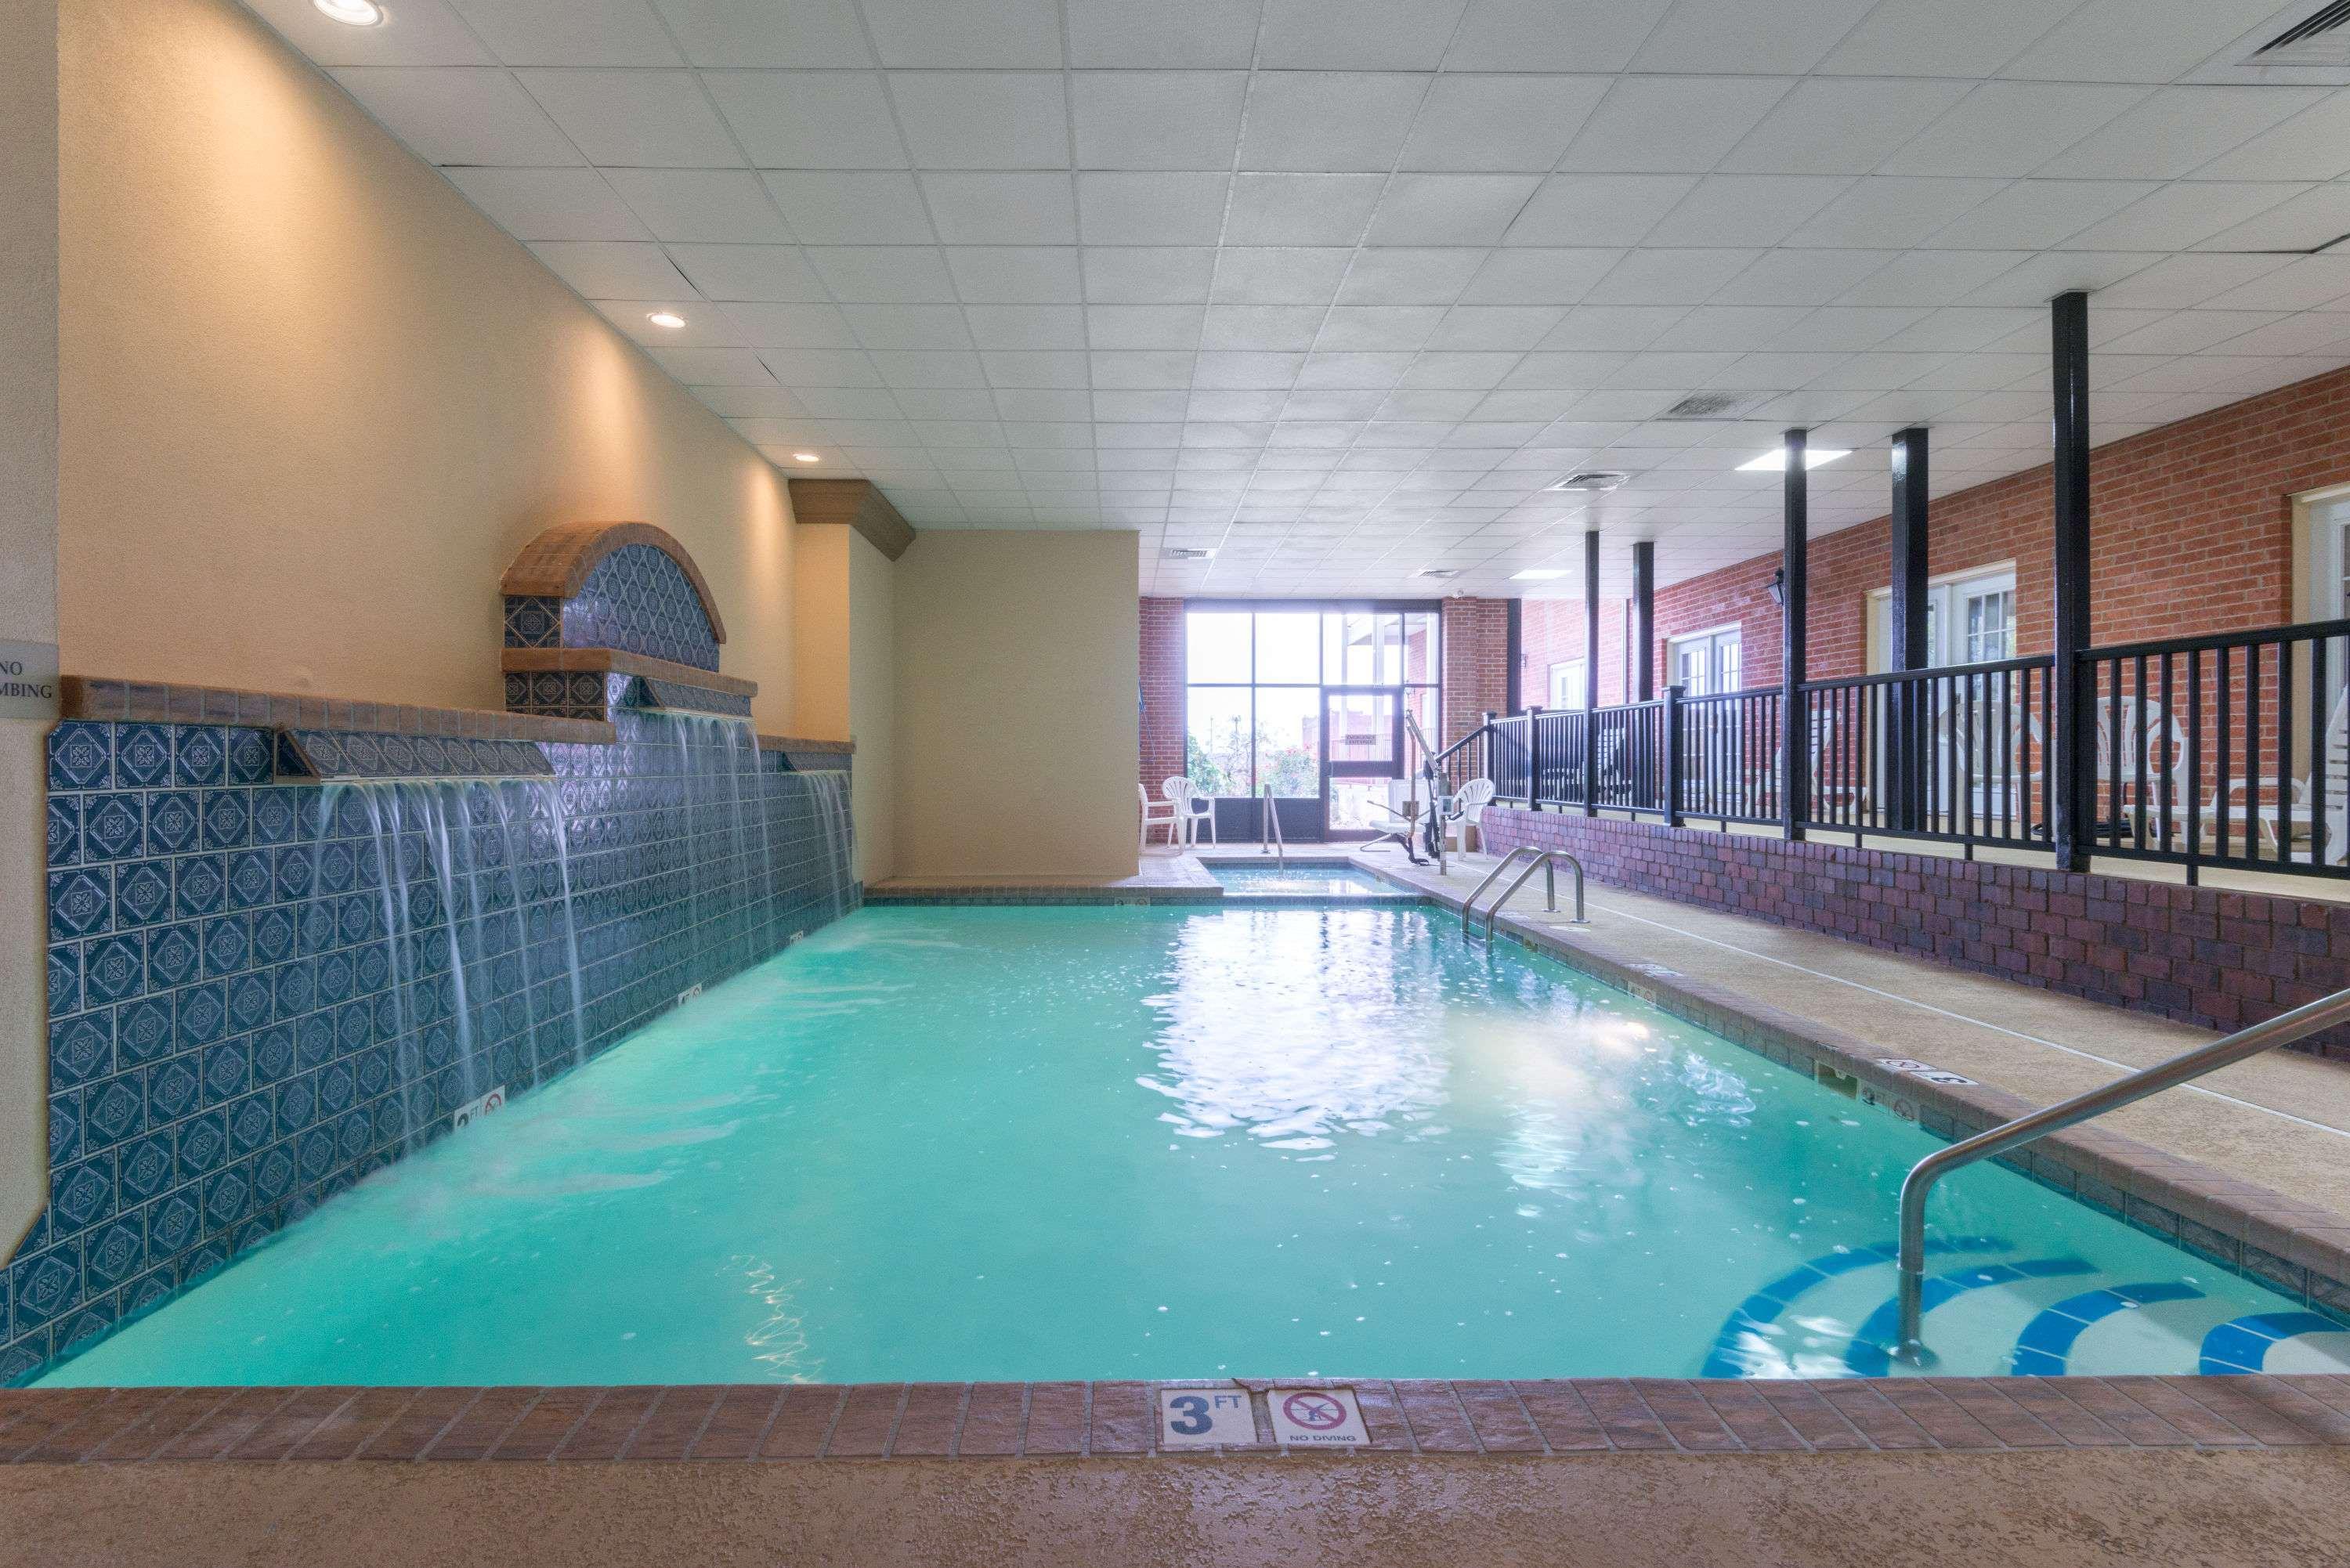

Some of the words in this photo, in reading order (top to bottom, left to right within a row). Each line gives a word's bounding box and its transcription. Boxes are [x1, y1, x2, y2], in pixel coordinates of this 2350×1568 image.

[0, 661, 22, 675] NO
[1170, 1396, 1213, 1435] 3
[1215, 1395, 1242, 1408] FT
